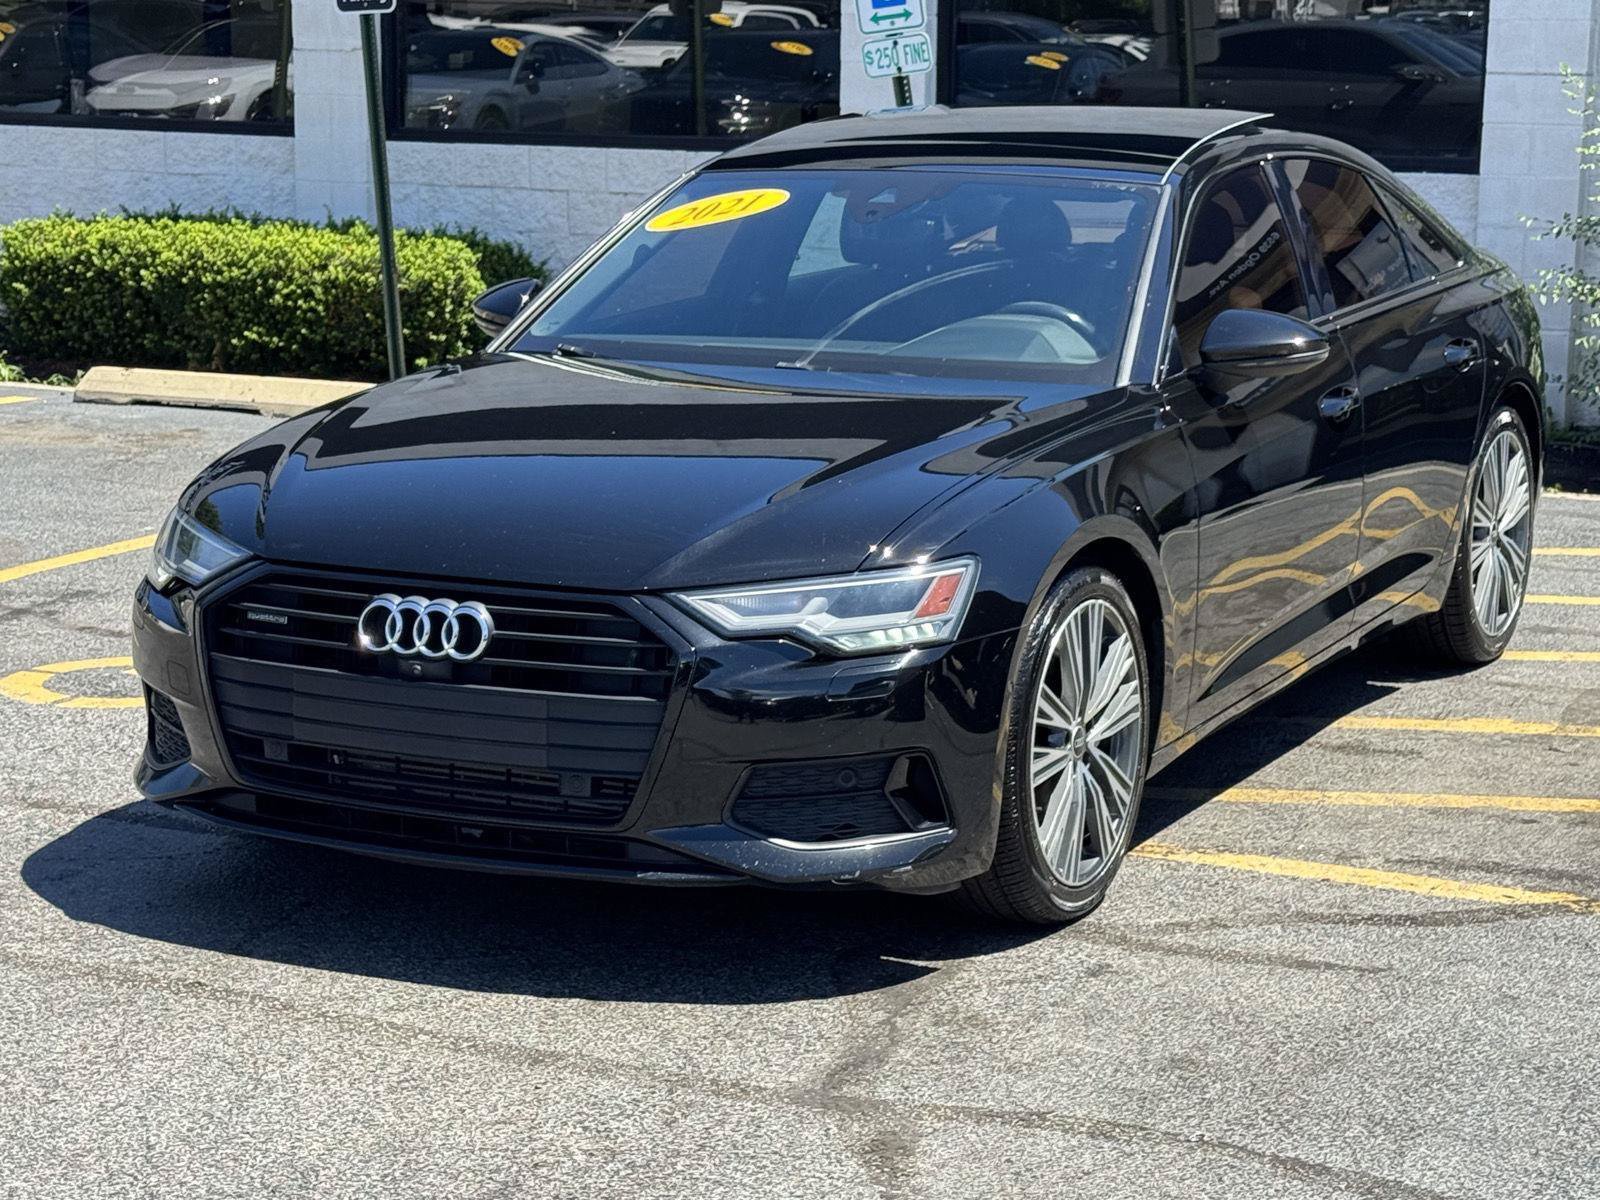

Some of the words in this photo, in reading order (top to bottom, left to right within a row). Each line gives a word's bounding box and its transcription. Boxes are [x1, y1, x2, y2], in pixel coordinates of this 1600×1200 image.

[864, 46, 900, 70] $250
[903, 41, 930, 66] FINE
[667, 193, 766, 226] 2021
